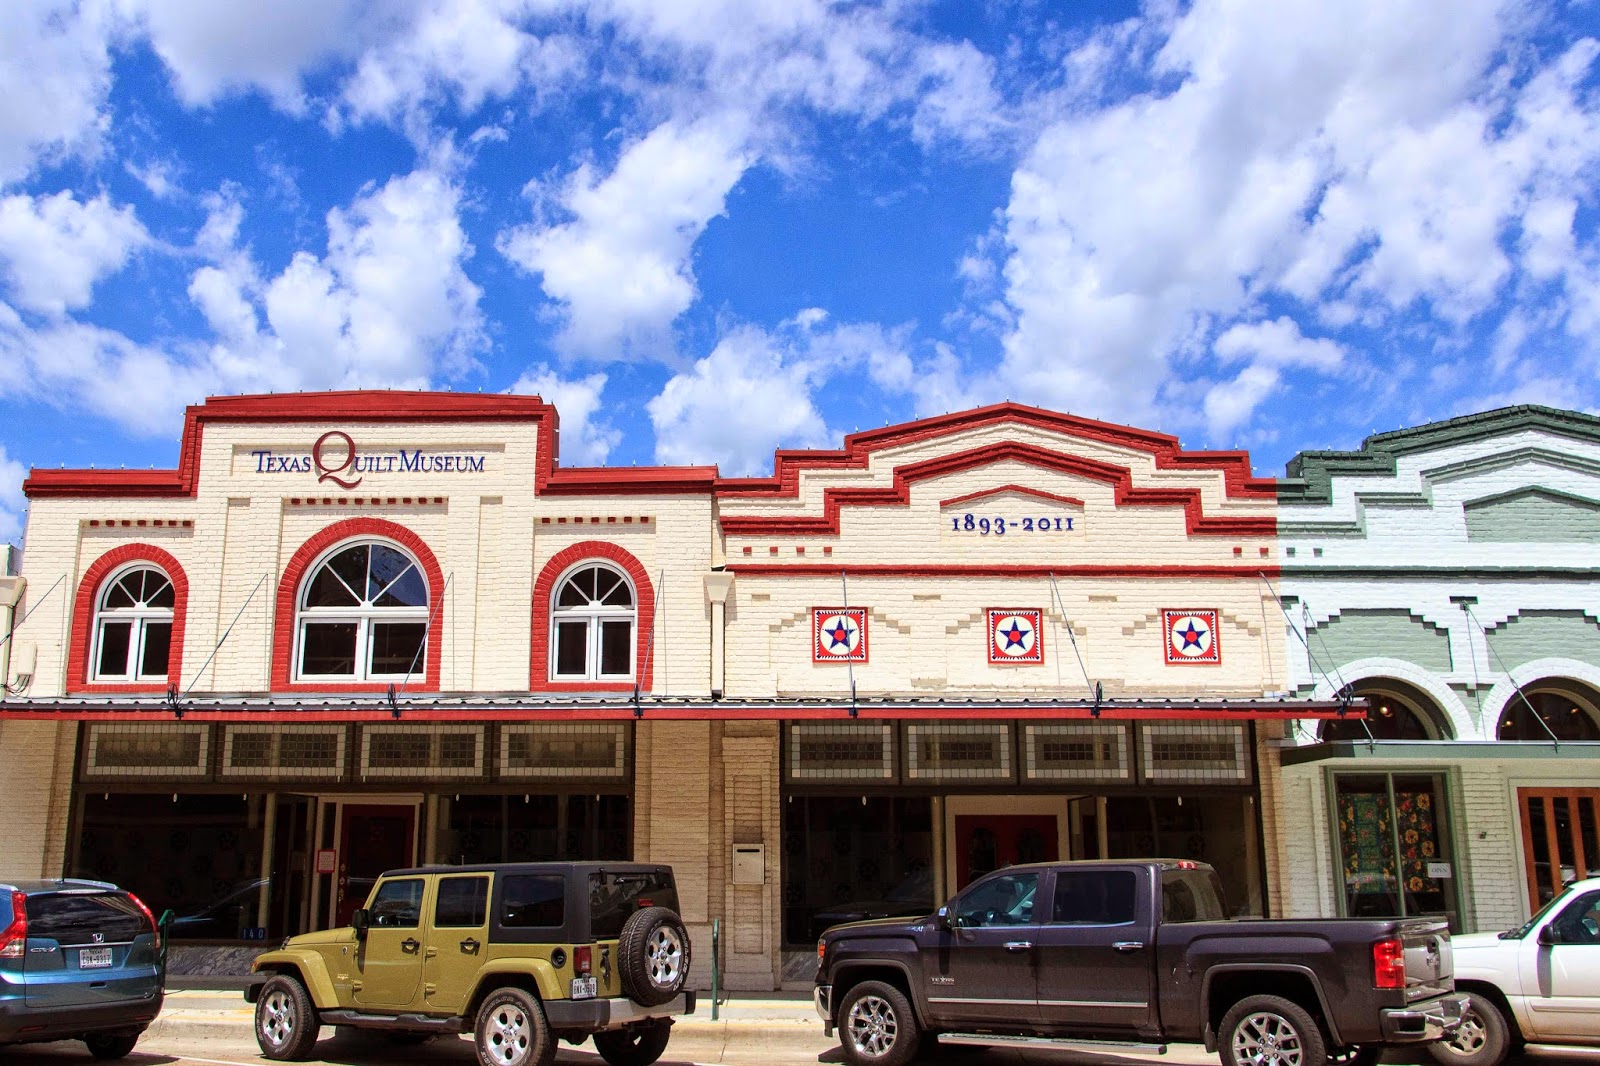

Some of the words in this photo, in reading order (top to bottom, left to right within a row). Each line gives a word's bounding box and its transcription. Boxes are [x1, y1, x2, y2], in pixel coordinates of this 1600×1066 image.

[251, 450, 311, 473] TEXAS
[399, 450, 486, 473] MUSEUM
[952, 513, 1074, 535] 1893-2011
[243, 928, 264, 939] 140
